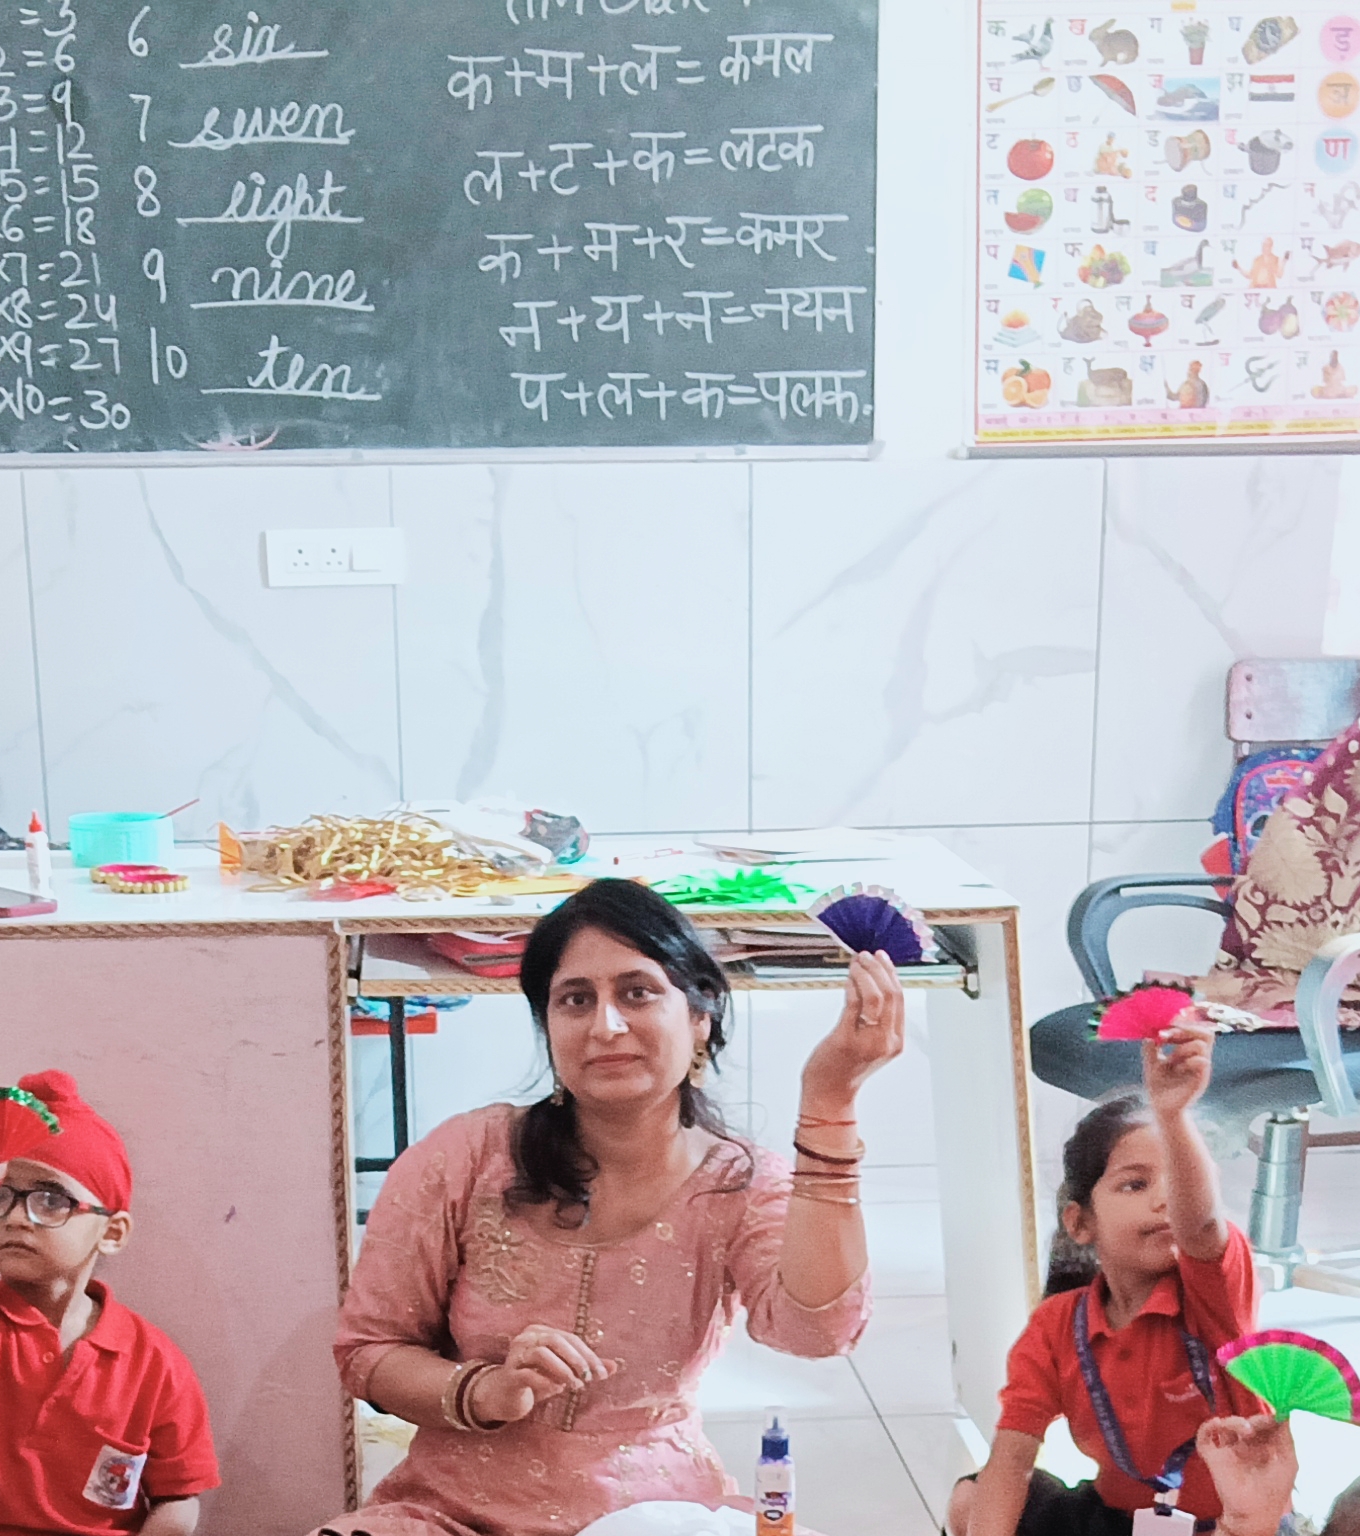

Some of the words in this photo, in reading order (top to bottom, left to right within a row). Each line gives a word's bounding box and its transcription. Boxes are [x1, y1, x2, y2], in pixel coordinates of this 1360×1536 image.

[128, 6, 151, 57] 6
[200, 11, 296, 65] six
[129, 93, 152, 142] 7
[188, 101, 356, 150] seven
[134, 165, 161, 217] 8
[222, 169, 348, 261] eight
[142, 248, 168, 304] 9
[210, 258, 369, 304] nine
[150, 327, 188, 385] 10
[246, 334, 368, 399] ten
